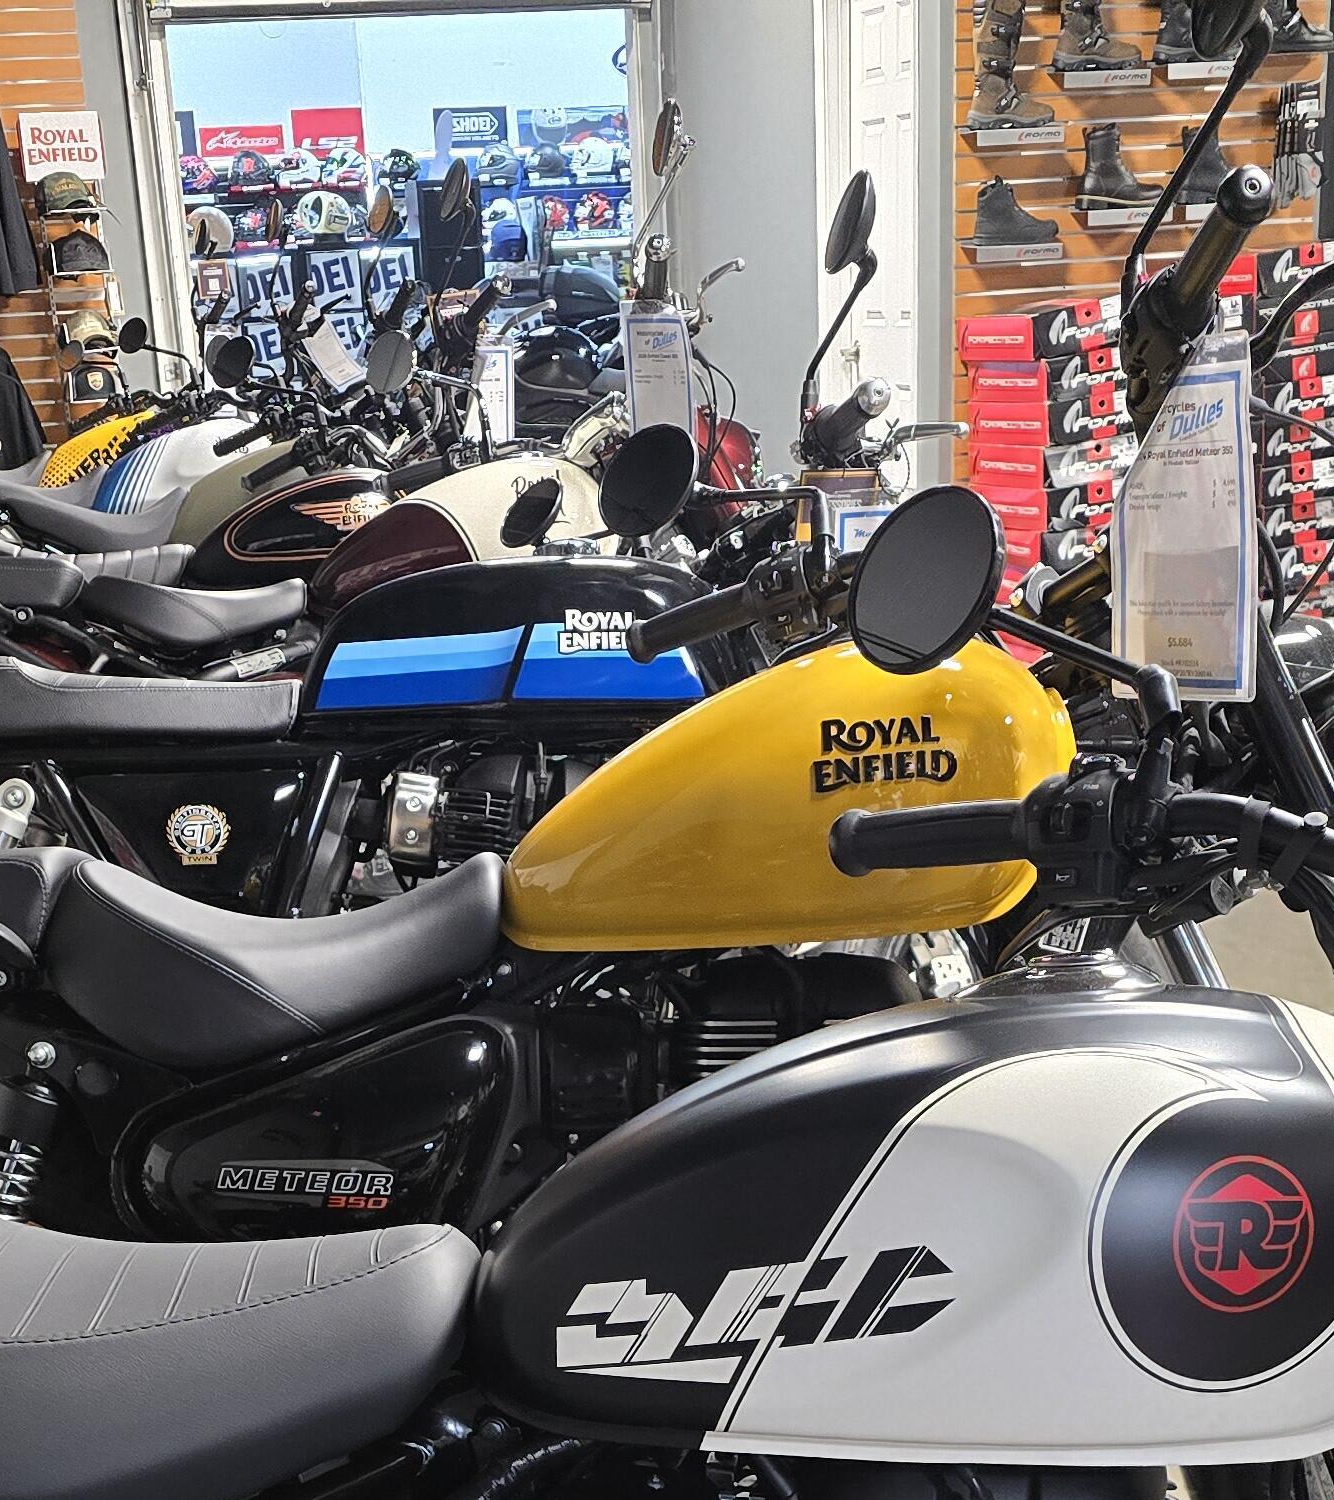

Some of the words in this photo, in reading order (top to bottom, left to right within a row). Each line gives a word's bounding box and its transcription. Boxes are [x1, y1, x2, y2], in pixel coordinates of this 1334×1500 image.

[452, 116, 491, 133] SHOEI
[30, 127, 89, 146] ROYAL
[301, 136, 358, 150] LS2
[27, 146, 98, 166] ENFIELD
[1156, 420, 1167, 434] of
[1169, 398, 1224, 441] Dulles
[1147, 449, 1166, 461] Royal
[1167, 447, 1194, 459] Enfield
[1195, 446, 1220, 457] Meteor
[1222, 445, 1234, 455] 350
[565, 609, 633, 632] ROYAL
[558, 630, 627, 655] ENFIE
[820, 714, 941, 754] ROYAL
[812, 749, 958, 794] ENFIELD
[180, 820, 214, 847] GT
[187, 855, 213, 863] TWIN
[217, 1167, 395, 1195] METEOR
[327, 1195, 389, 1209] 350
